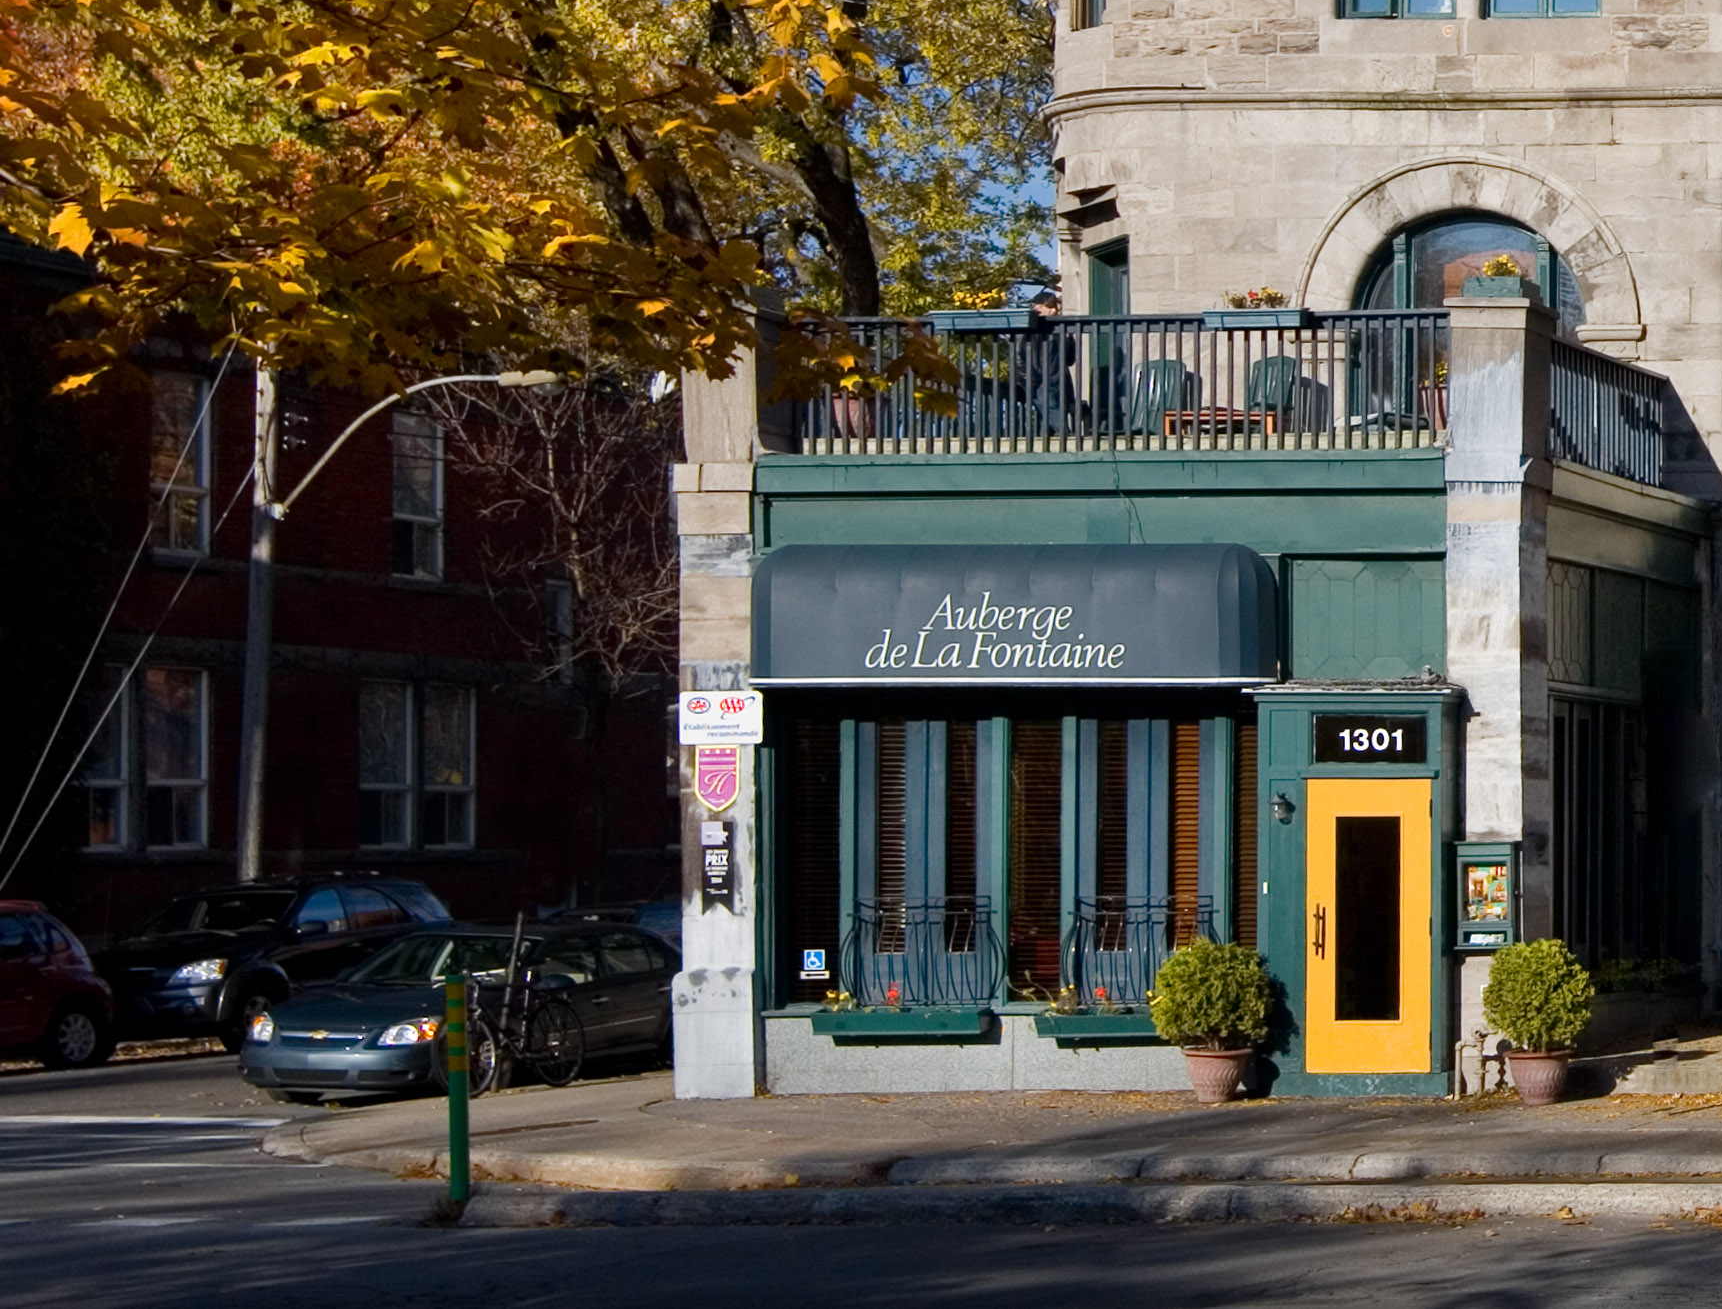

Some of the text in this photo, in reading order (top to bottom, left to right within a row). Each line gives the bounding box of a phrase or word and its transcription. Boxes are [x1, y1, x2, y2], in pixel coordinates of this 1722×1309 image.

[922, 591, 1073, 640] Auberge
[864, 628, 1126, 669] de La Fontaine
[1339, 728, 1404, 751] 1301
[705, 854, 729, 866] PRIX
